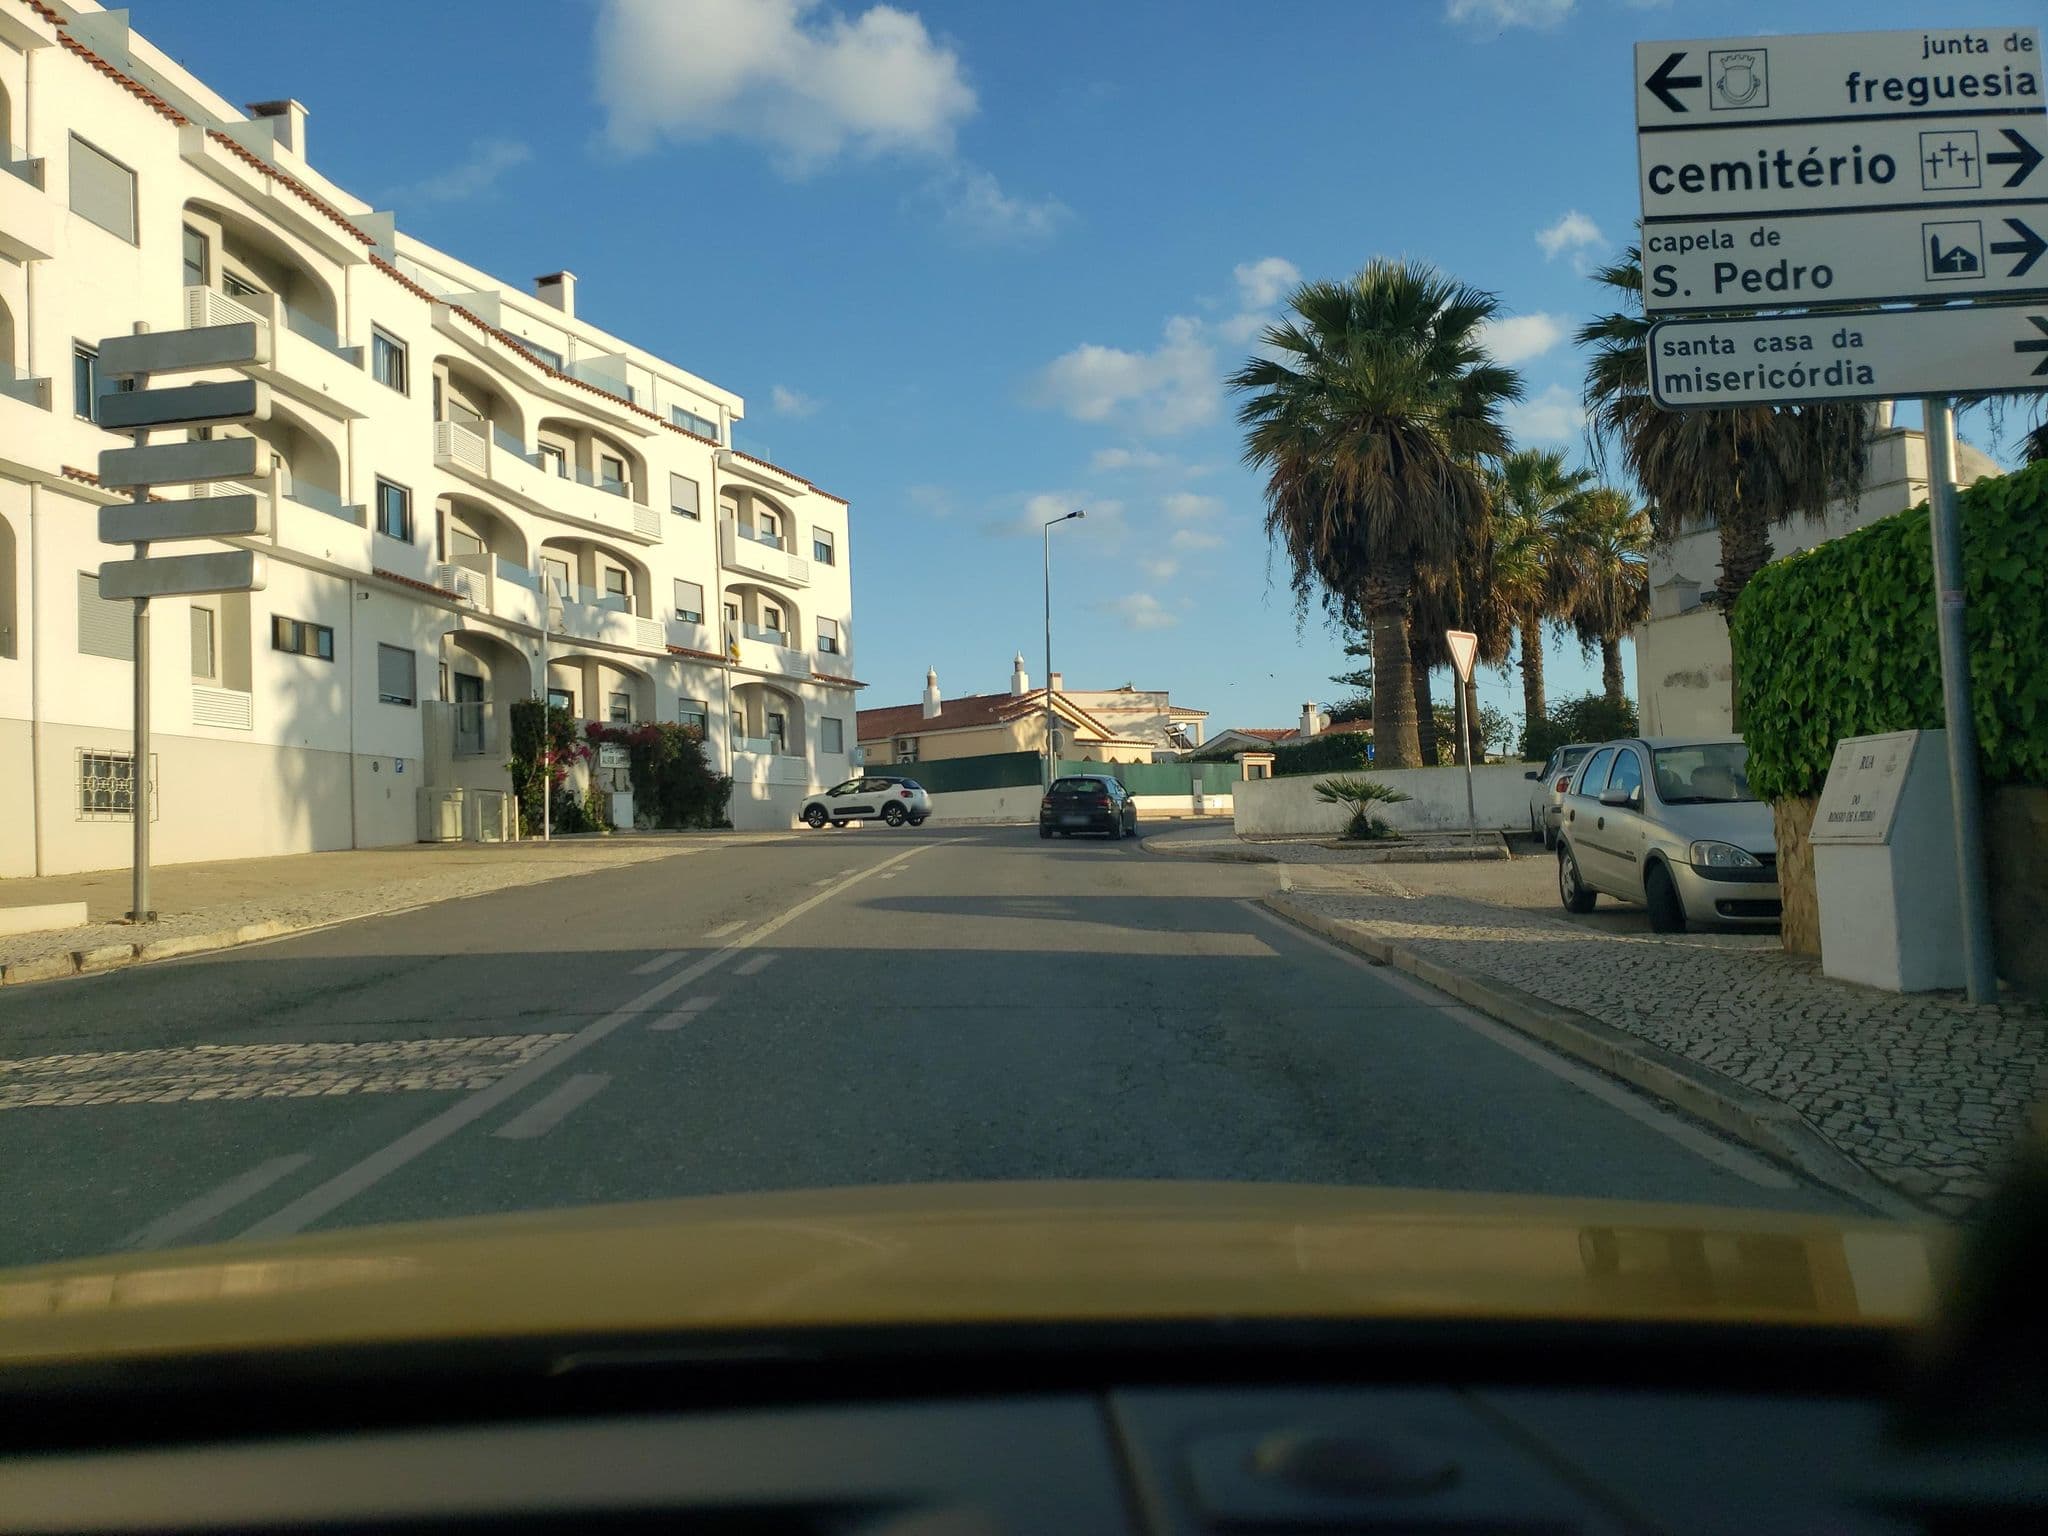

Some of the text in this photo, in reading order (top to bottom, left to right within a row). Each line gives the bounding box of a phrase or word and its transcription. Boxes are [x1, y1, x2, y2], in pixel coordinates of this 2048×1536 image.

[1922, 32, 2034, 59] junta de
[1845, 66, 2038, 107] freguesia
[1648, 144, 1897, 196] cemitério
[1648, 226, 1781, 255] capela de
[1650, 259, 1834, 298] S. Pedro
[1663, 328, 1864, 357] santa casa da
[1664, 361, 1874, 394] misericórdia
